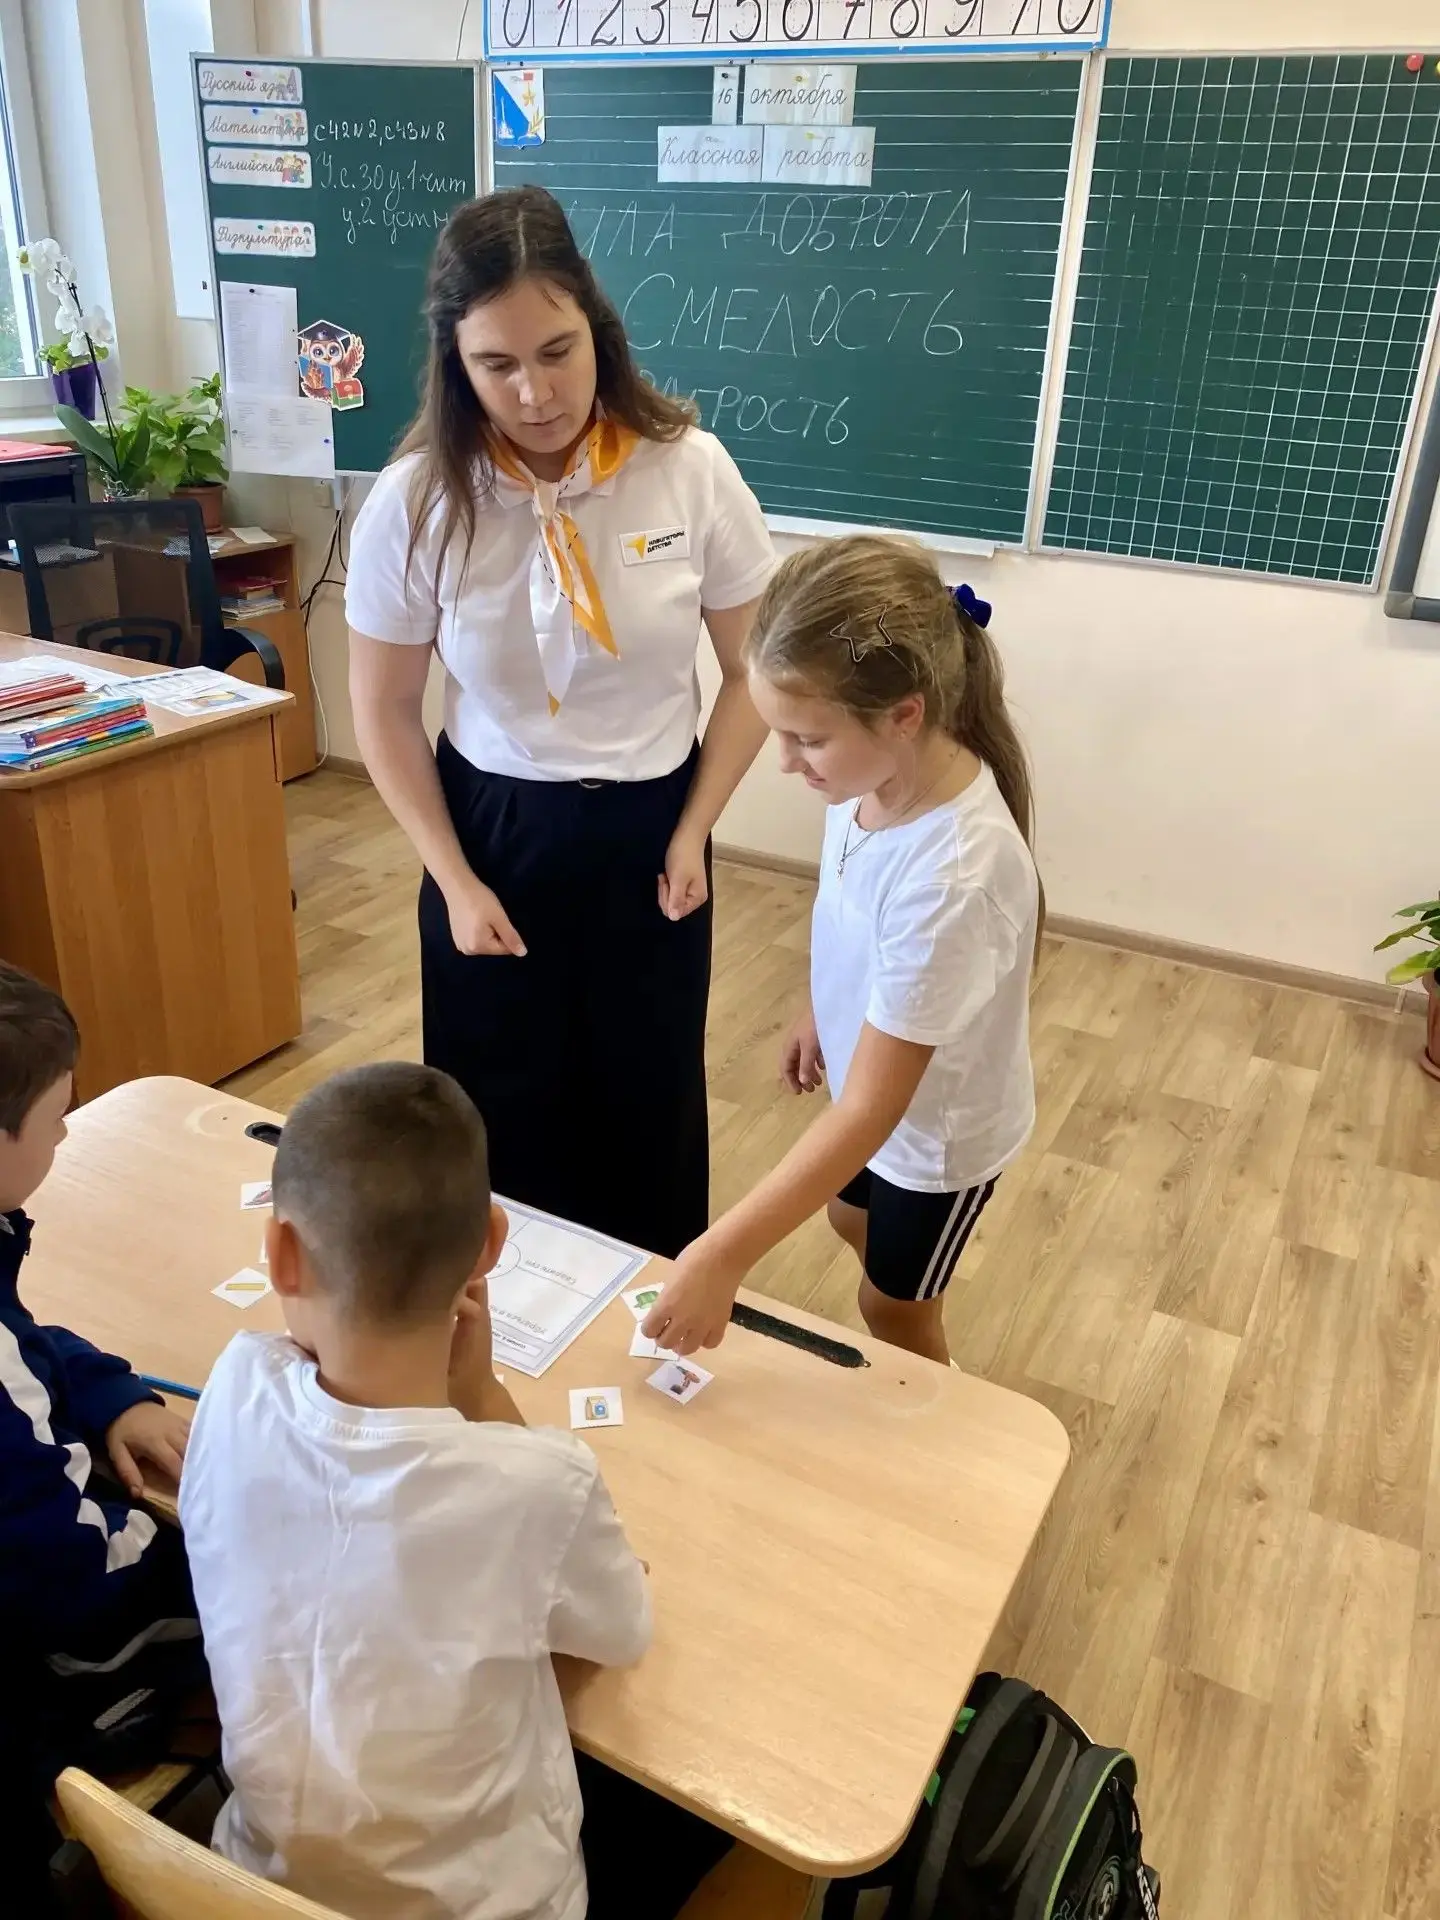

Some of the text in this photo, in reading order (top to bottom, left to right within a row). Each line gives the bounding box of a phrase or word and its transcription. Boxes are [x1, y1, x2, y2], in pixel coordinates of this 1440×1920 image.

[200, 70, 256, 97] Русский
[717, 73, 848, 118] 16 октября
[210, 152, 284, 173] Английский
[660, 136, 870, 177] Классная работа
[567, 188, 973, 259] ИЛА ДОБРОТА
